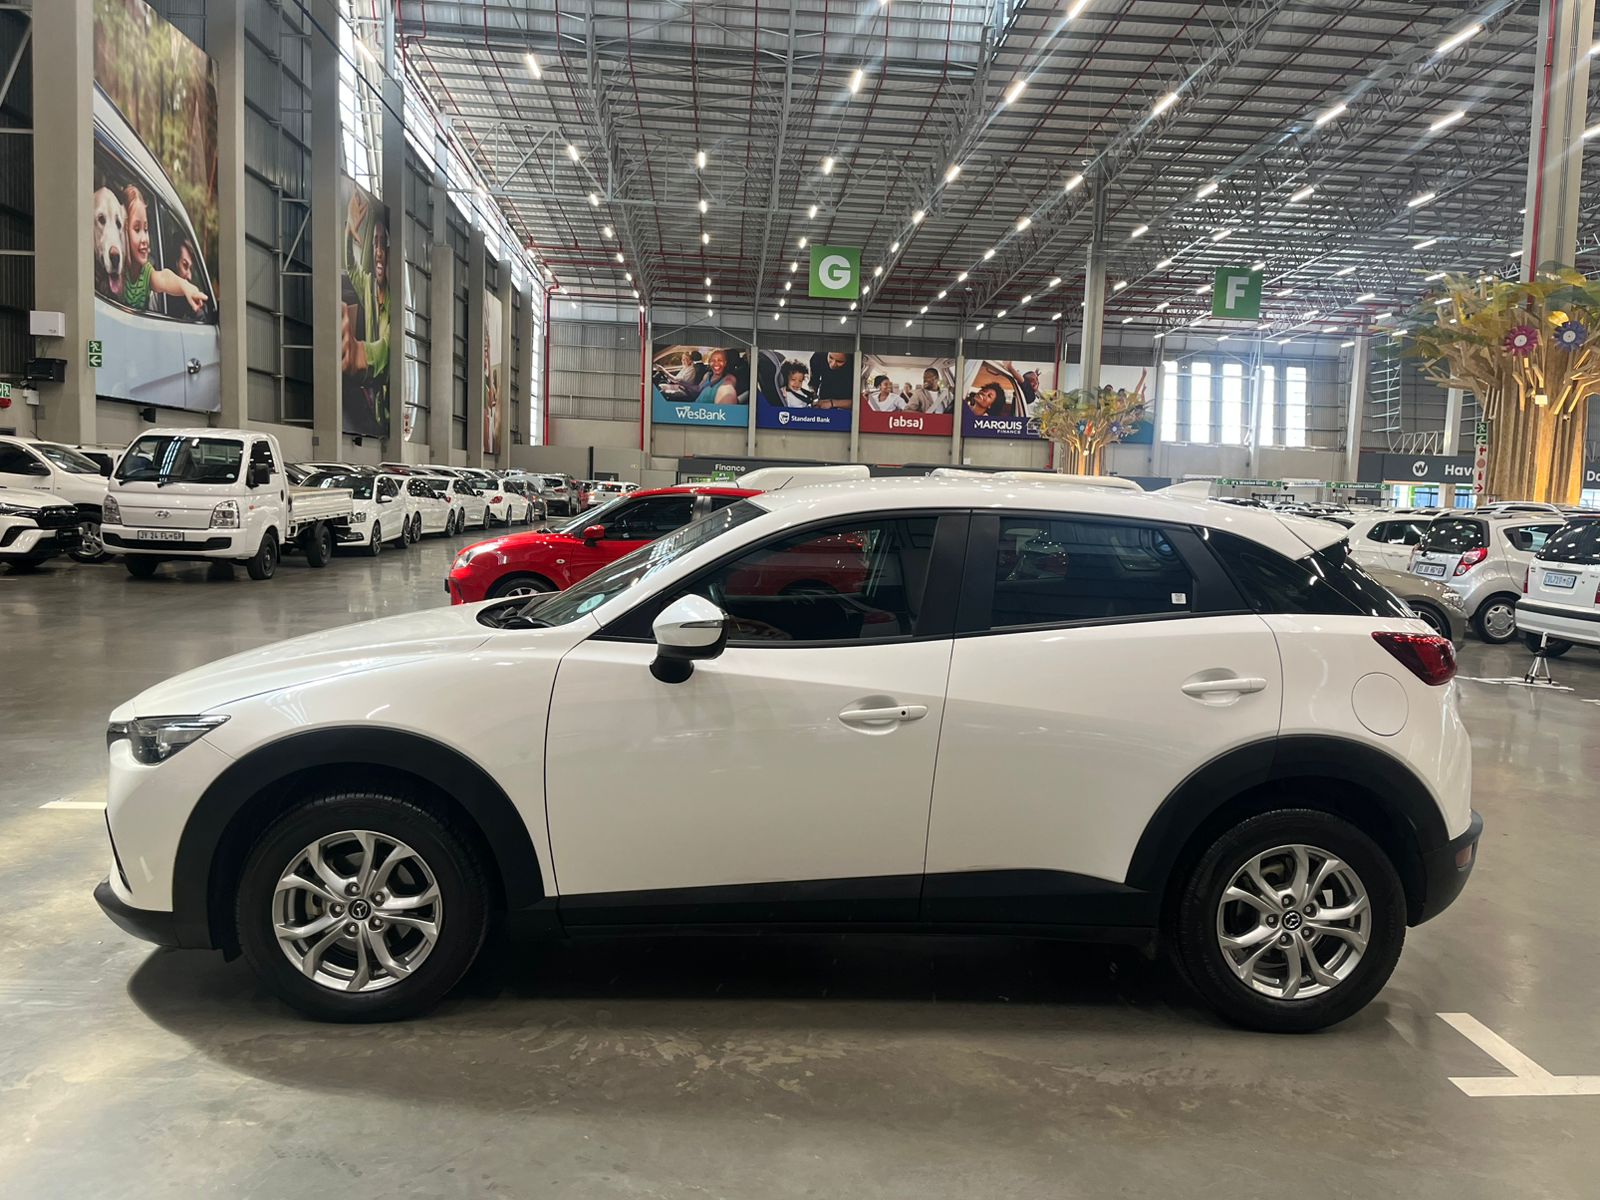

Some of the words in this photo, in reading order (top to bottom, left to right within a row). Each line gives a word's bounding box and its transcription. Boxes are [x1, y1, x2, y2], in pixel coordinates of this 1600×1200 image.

[819, 254, 851, 290] G
[1225, 276, 1249, 309] F
[675, 406, 726, 421] WesBank
[791, 415, 816, 423] Standard
[816, 416, 831, 424] Bank
[974, 419, 1022, 430] MARQUIS
[715, 463, 746, 472] Finance
[1445, 464, 1475, 476] Hav
